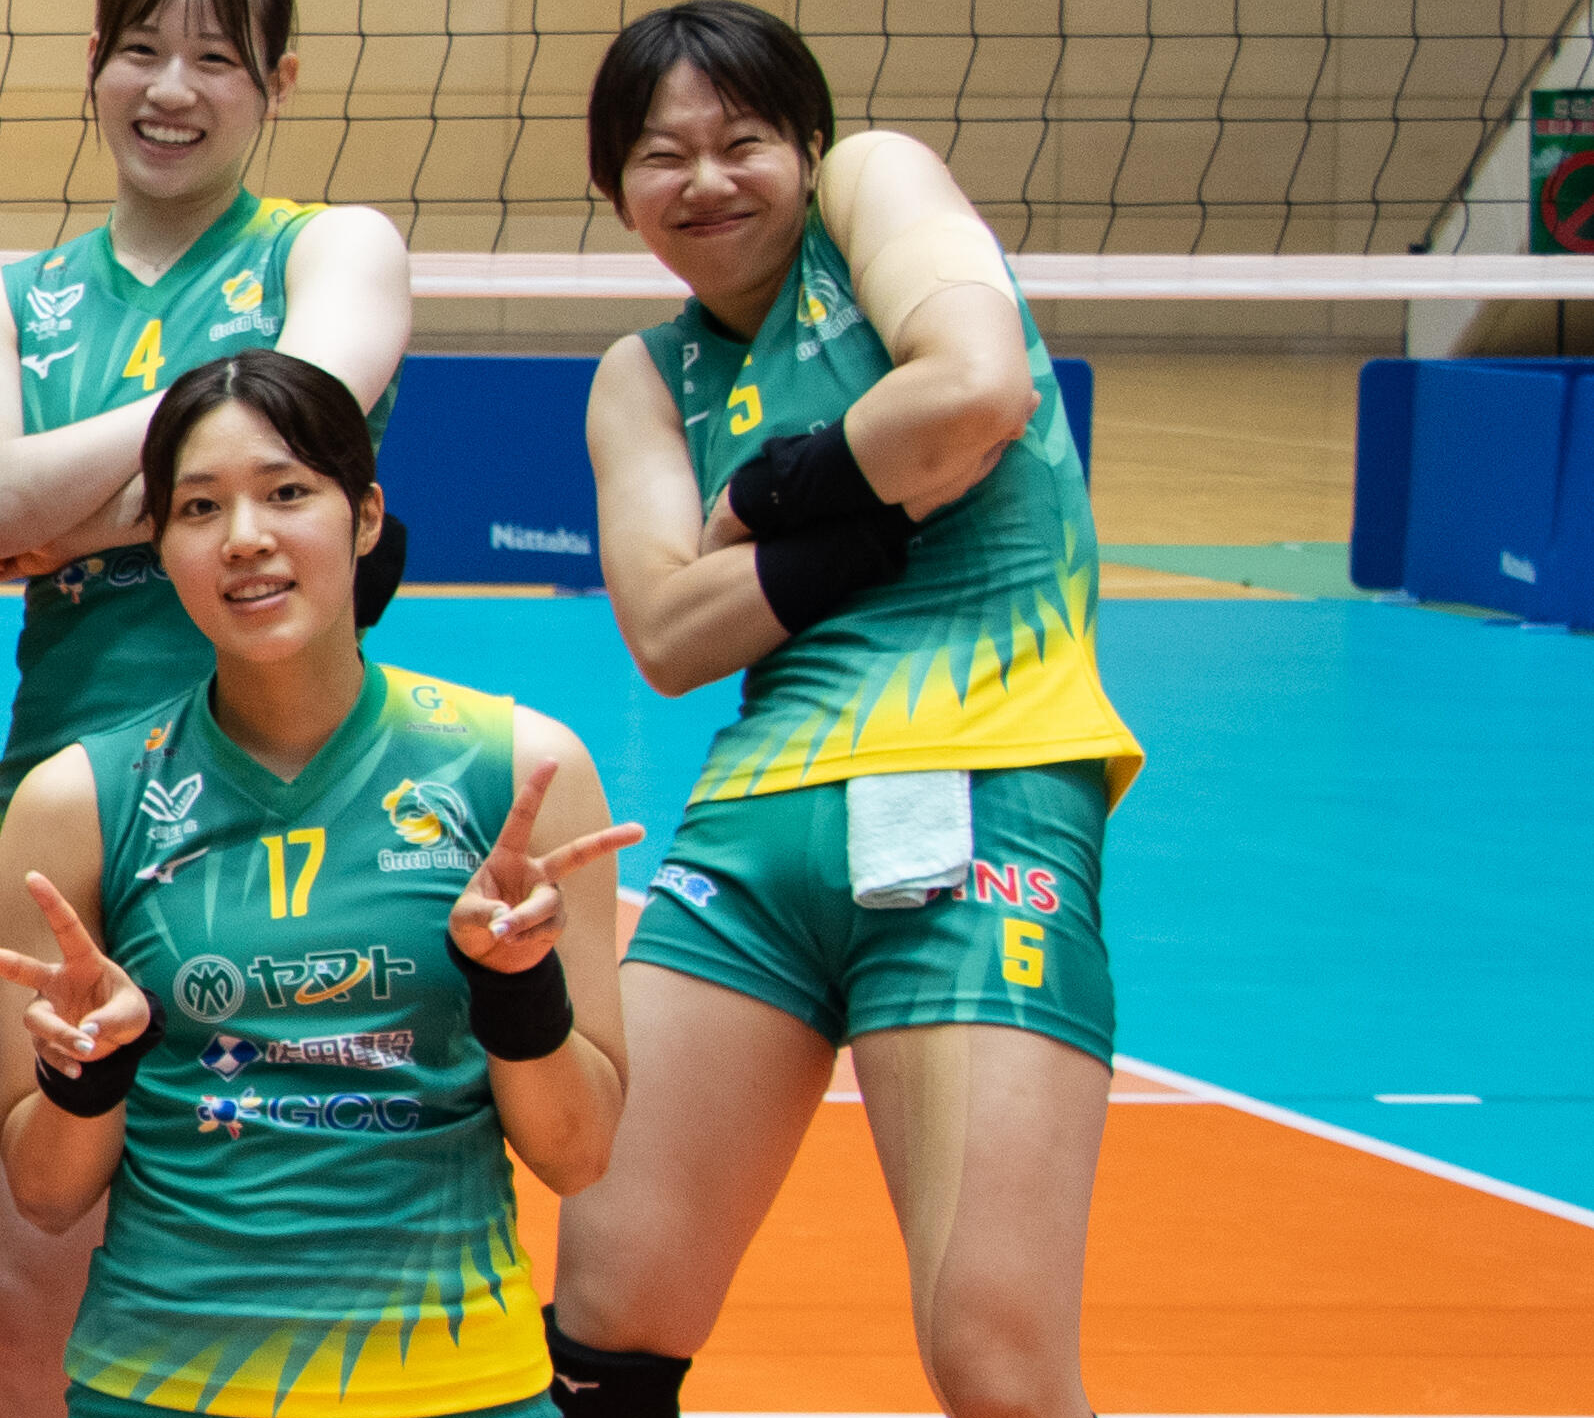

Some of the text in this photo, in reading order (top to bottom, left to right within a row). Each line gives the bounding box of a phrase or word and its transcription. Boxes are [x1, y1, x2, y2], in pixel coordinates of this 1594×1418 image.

[122, 319, 166, 391] 4
[261, 827, 325, 919] 17
[248, 946, 416, 1009] ヤマト
[1002, 918, 1045, 988] 5
[268, 1093, 422, 1133] GCC
